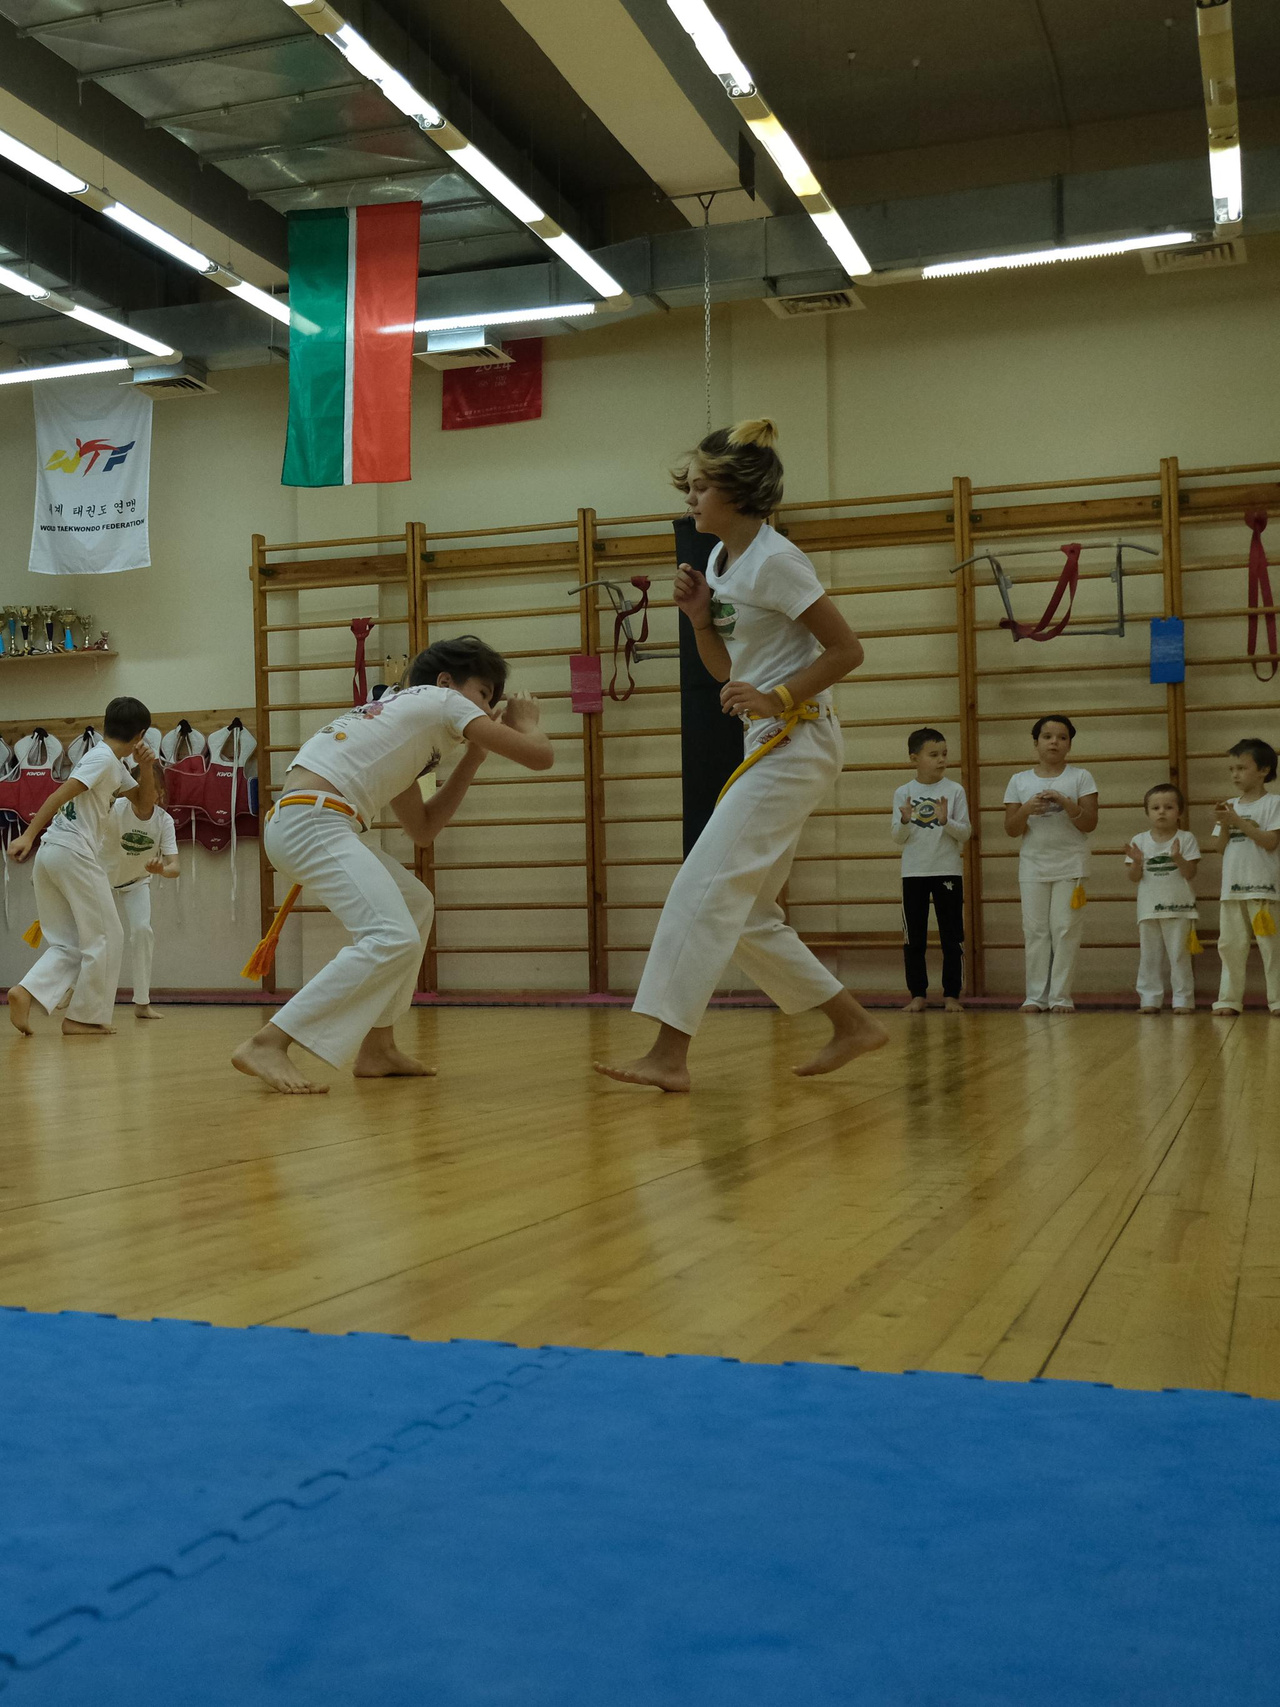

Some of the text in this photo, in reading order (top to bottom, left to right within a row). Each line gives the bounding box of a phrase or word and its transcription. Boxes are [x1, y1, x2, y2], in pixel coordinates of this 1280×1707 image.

[72, 504, 108, 518] 태권도
[57, 524, 101, 533] TAEKWONDO
[101, 518, 145, 531] FEDERATION
